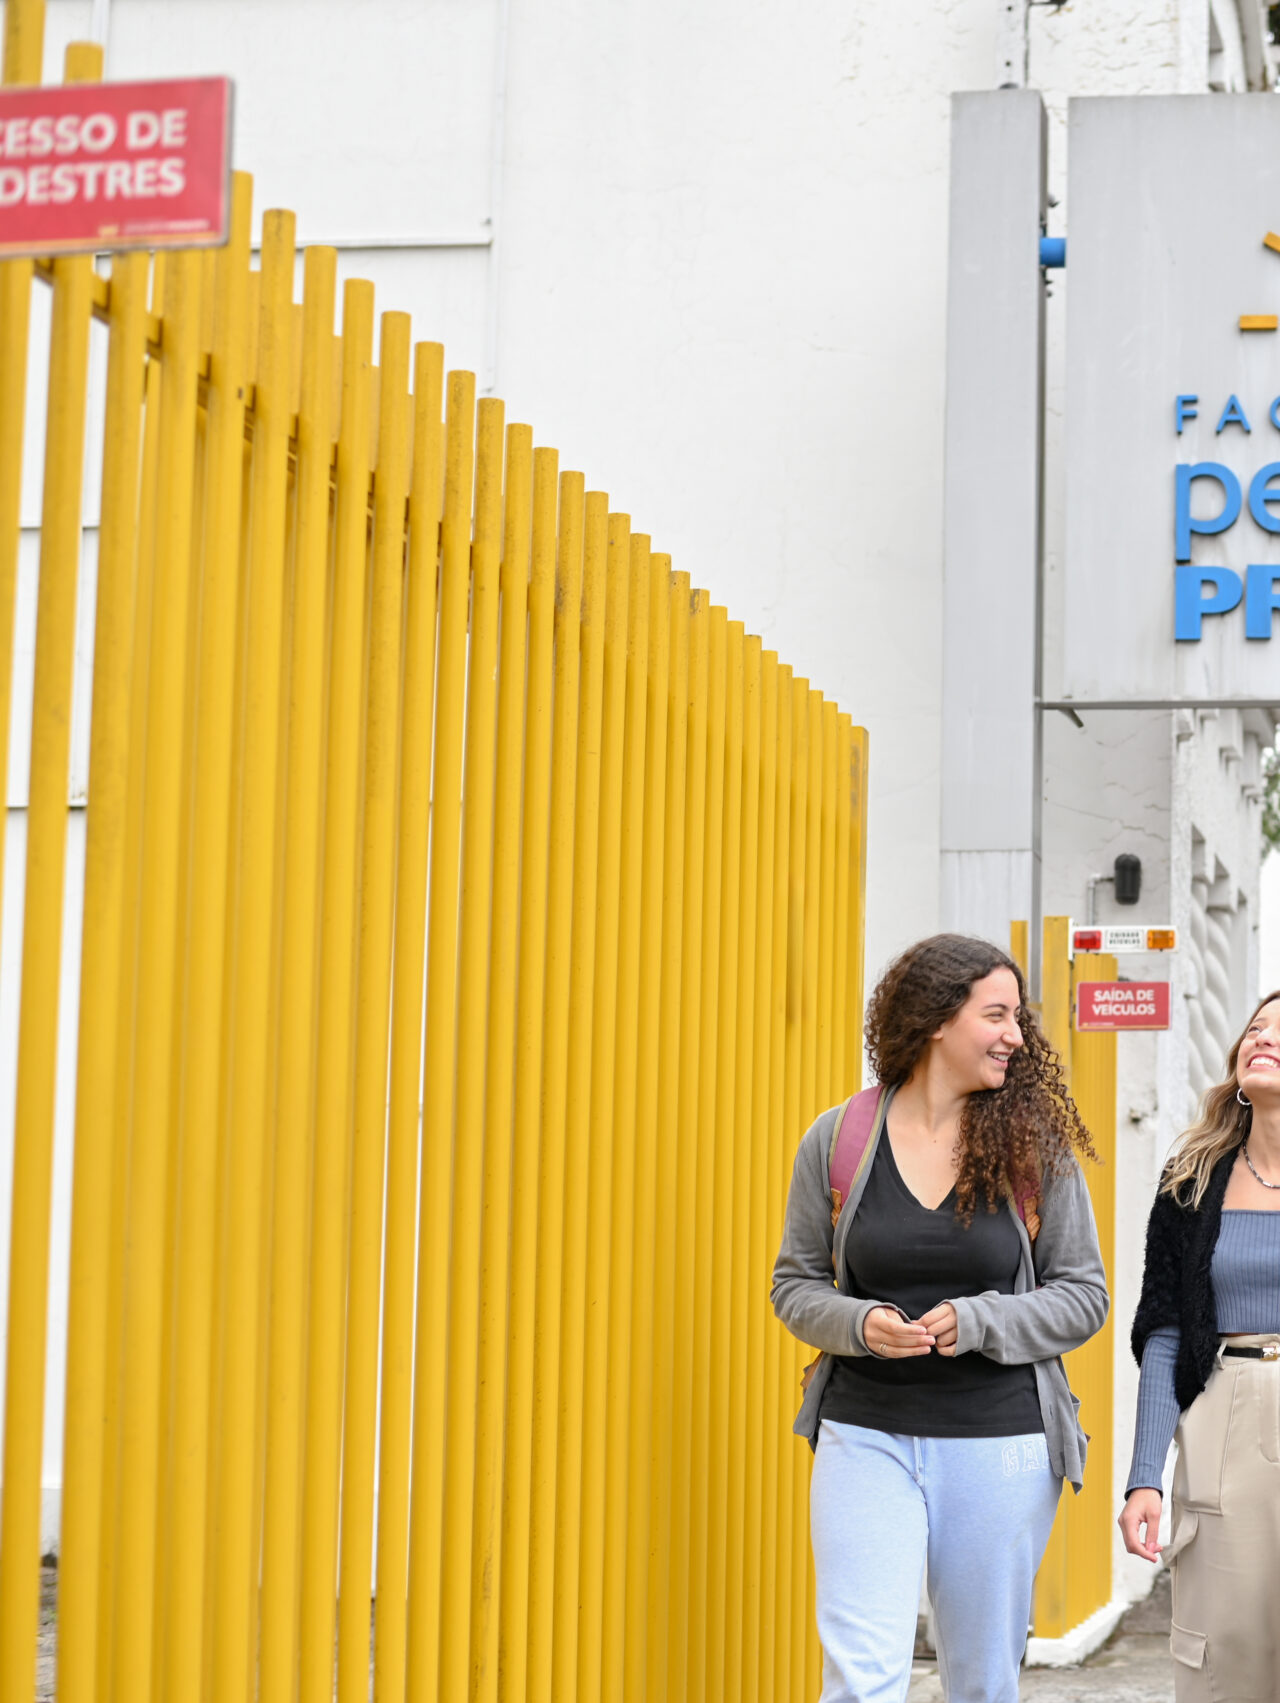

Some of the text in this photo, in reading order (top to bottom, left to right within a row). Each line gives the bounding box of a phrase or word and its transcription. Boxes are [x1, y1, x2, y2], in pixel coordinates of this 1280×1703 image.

[0, 108, 188, 157] ESSO DE
[0, 157, 187, 207] DESTRES
[1091, 1001, 1156, 1016] VEÍCULOS
[1093, 987, 1154, 1002] SAÍDA DE
